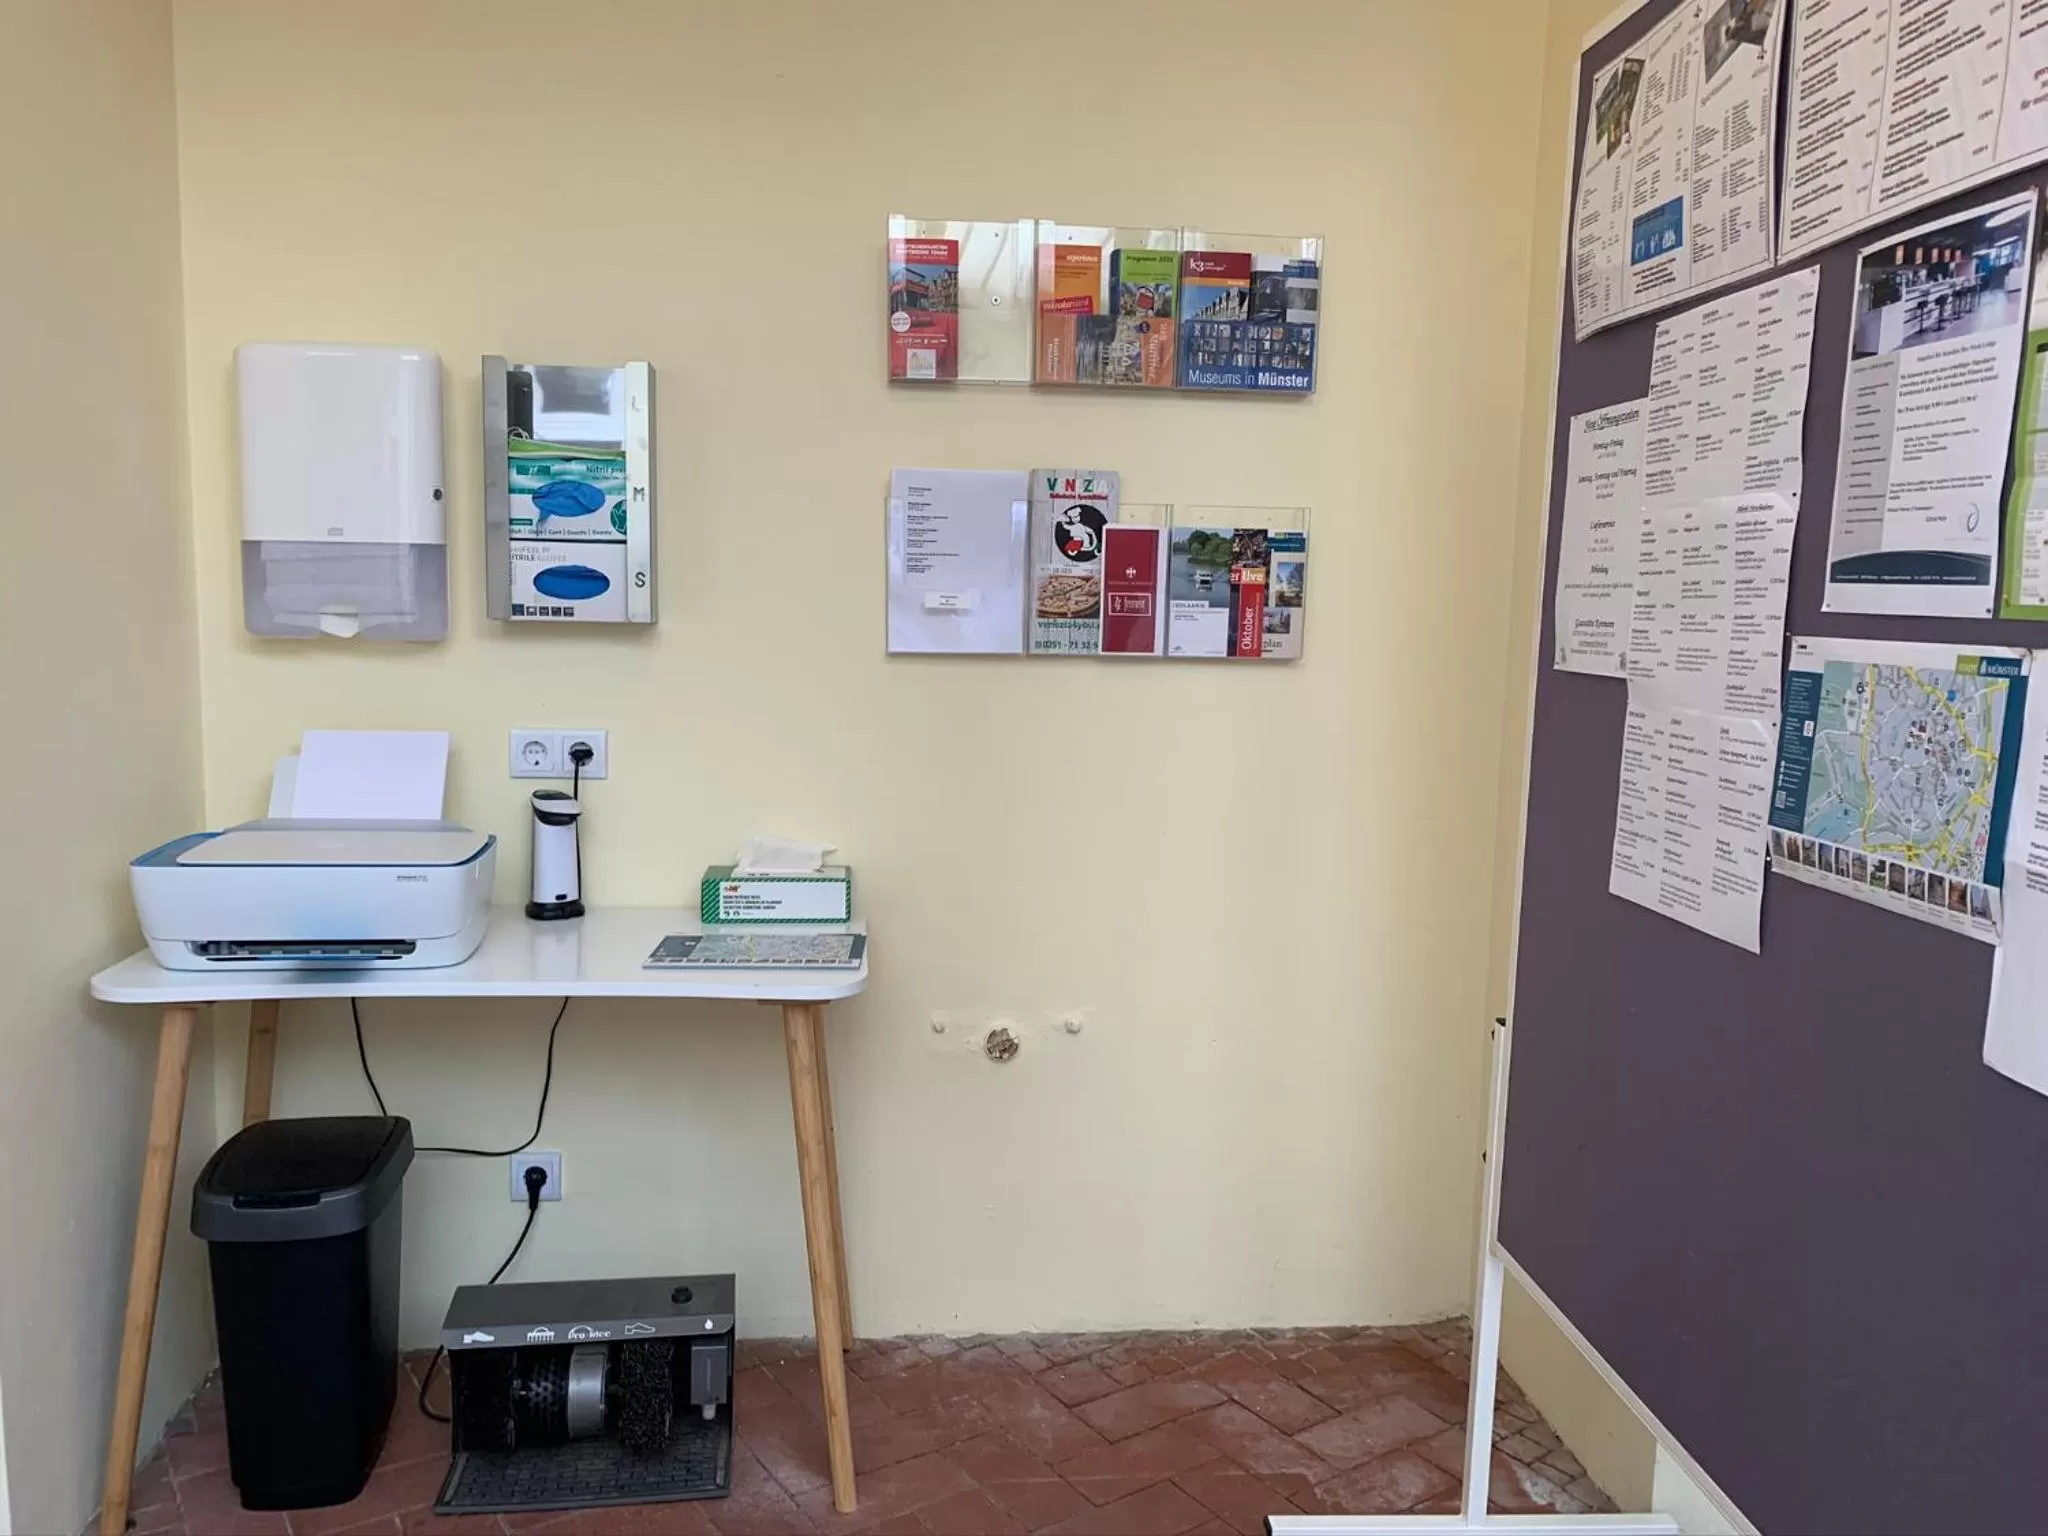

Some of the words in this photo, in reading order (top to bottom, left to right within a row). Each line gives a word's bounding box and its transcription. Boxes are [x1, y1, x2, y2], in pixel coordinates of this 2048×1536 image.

[1188, 369, 1241, 384] Museums
[1245, 370, 1255, 385] in
[1258, 371, 1309, 387] Münster
[633, 486, 646, 502] M
[634, 571, 646, 588] S
[1240, 607, 1254, 650] Oktober
[1987, 664, 2020, 676] MÜNSTER
